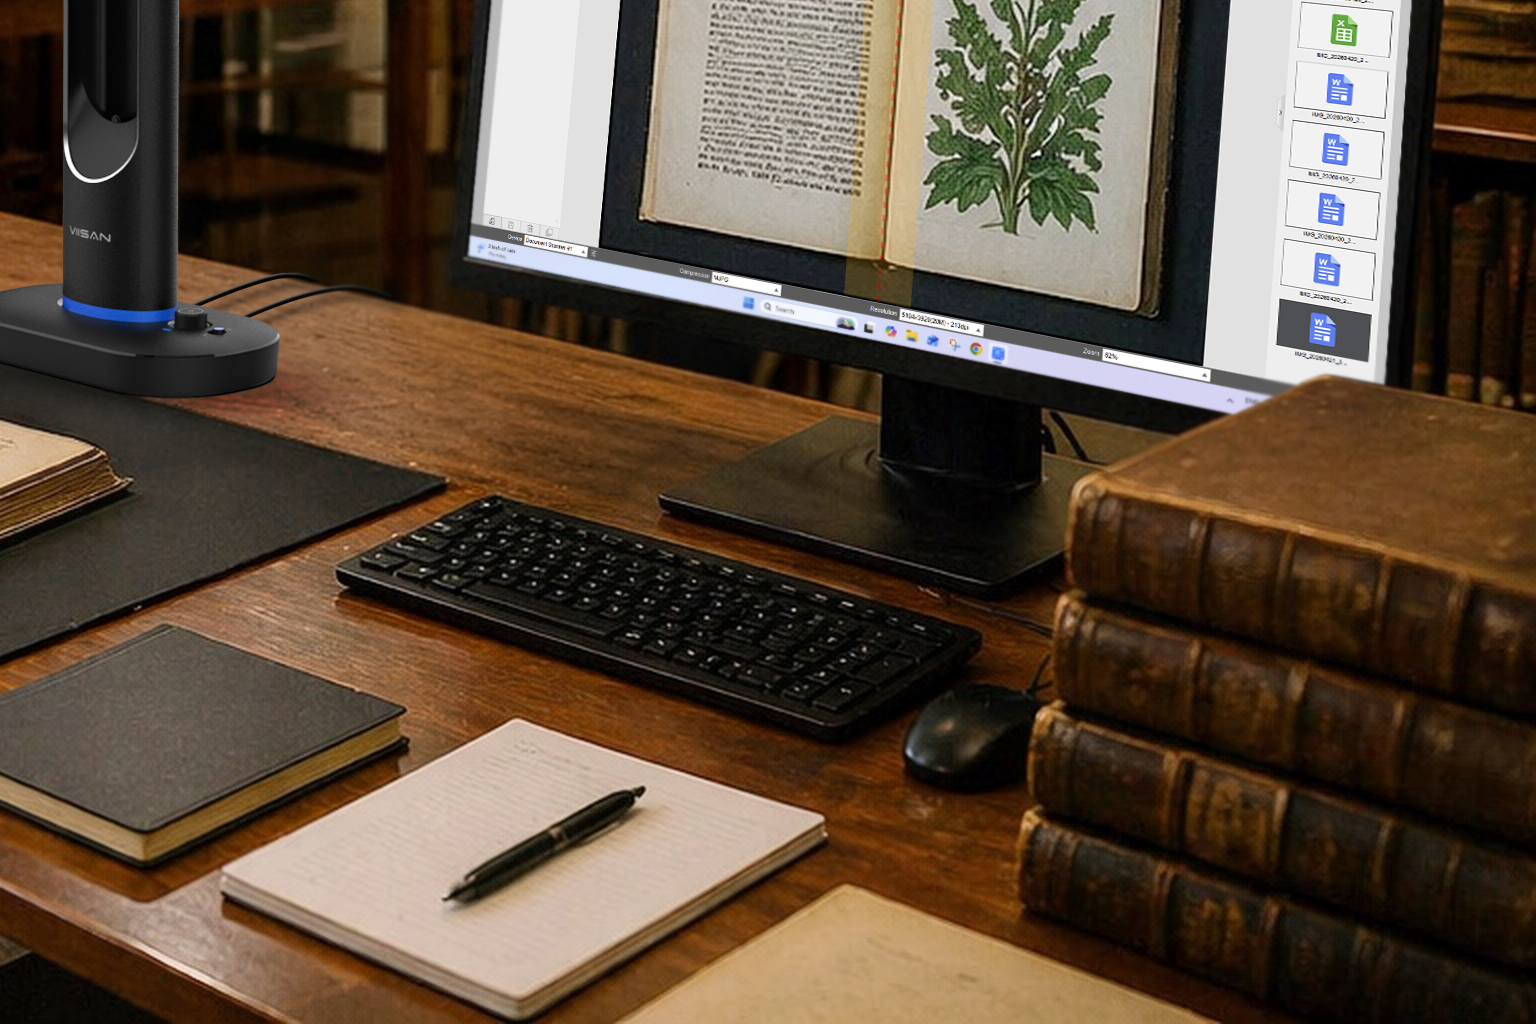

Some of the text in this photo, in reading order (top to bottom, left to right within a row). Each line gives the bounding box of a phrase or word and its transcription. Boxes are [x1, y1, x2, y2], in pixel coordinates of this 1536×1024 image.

[69, 226, 111, 243] VIISAN
[775, 306, 795, 315] Search
[870, 305, 897, 316] Resolution
[1083, 347, 1100, 356] Zoom
